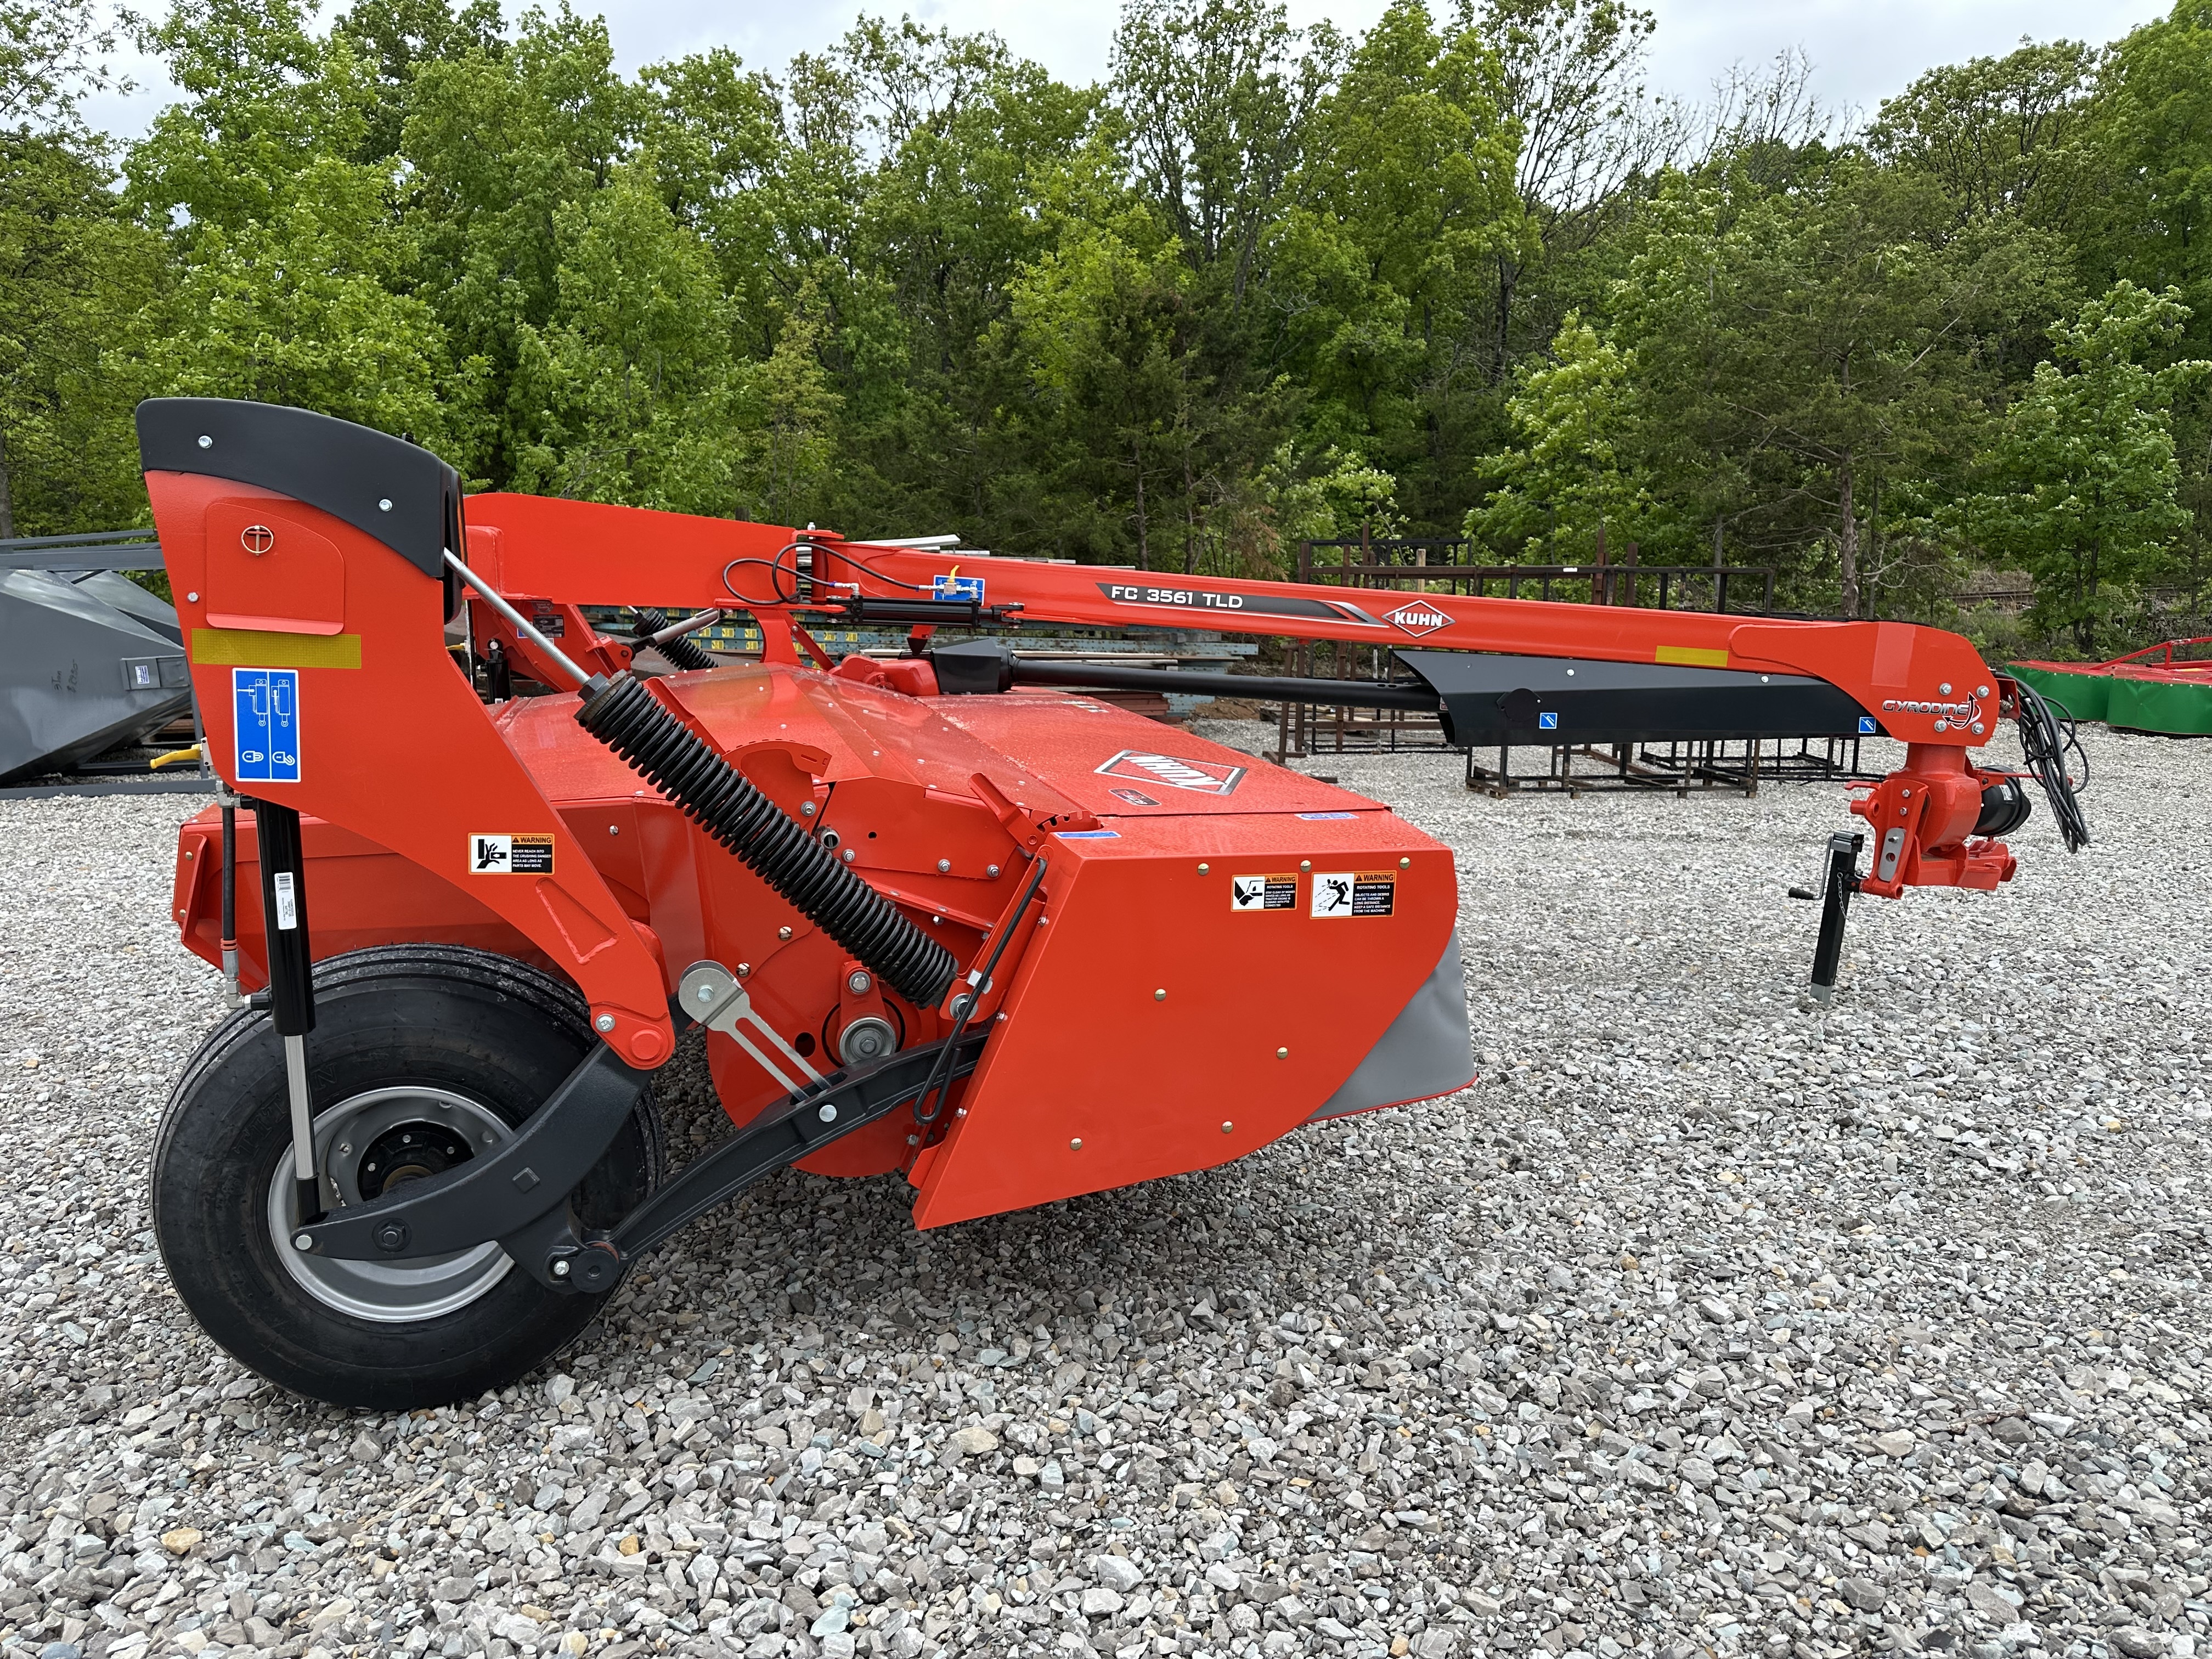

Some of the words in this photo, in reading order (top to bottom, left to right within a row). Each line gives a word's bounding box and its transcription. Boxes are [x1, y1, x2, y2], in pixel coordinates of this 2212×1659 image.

[1111, 586, 1138, 600] FC
[1147, 589, 1193, 605] 3561
[1203, 594, 1243, 608] TLD
[1395, 612, 1442, 627] KUHN
[1883, 700, 1969, 716] GYRODINE
[1122, 756, 1228, 786] KUHN
